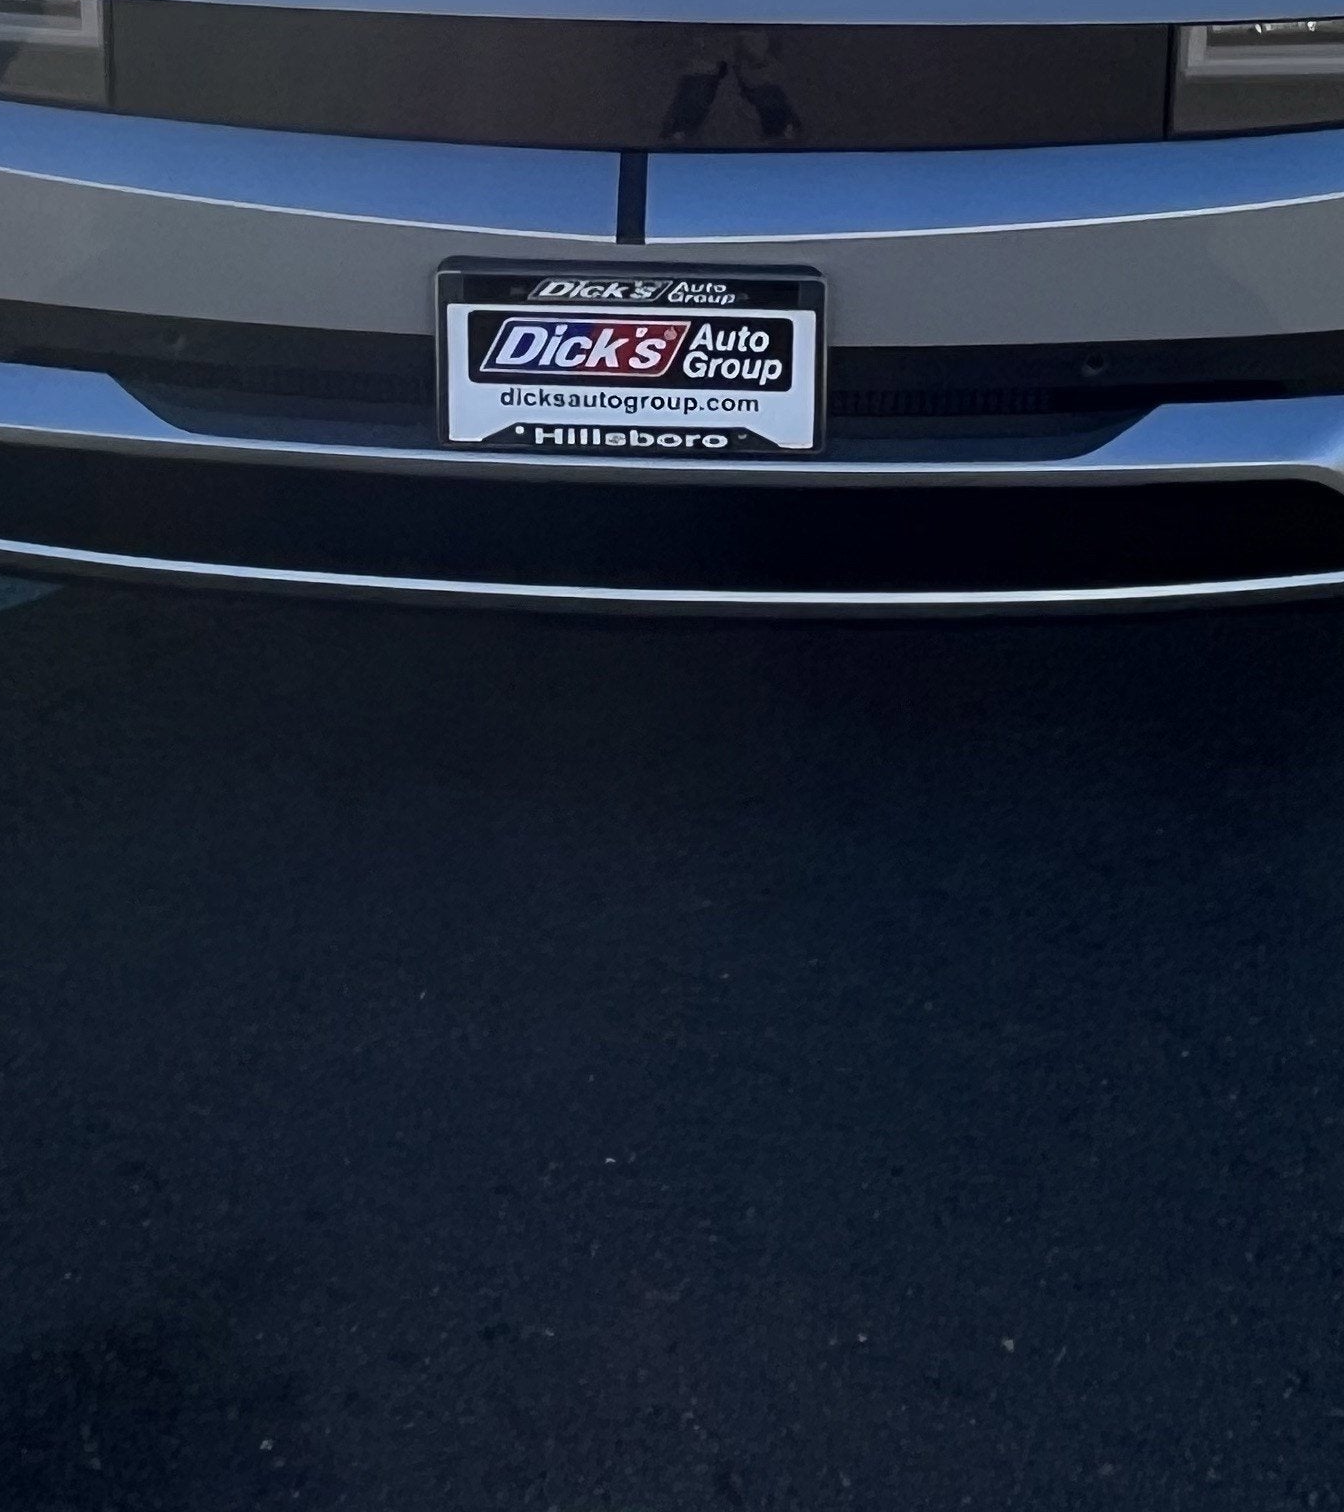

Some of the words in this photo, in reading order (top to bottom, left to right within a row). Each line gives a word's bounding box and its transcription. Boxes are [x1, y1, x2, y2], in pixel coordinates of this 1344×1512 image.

[538, 279, 656, 300] Dick's
[675, 281, 727, 294] Auto
[667, 292, 736, 306] Group
[494, 324, 668, 369] Dick's
[689, 323, 770, 353] Auto
[682, 351, 783, 386] Group
[500, 387, 759, 415] dicksautogroup.com
[534, 427, 729, 449] Hillsboro
